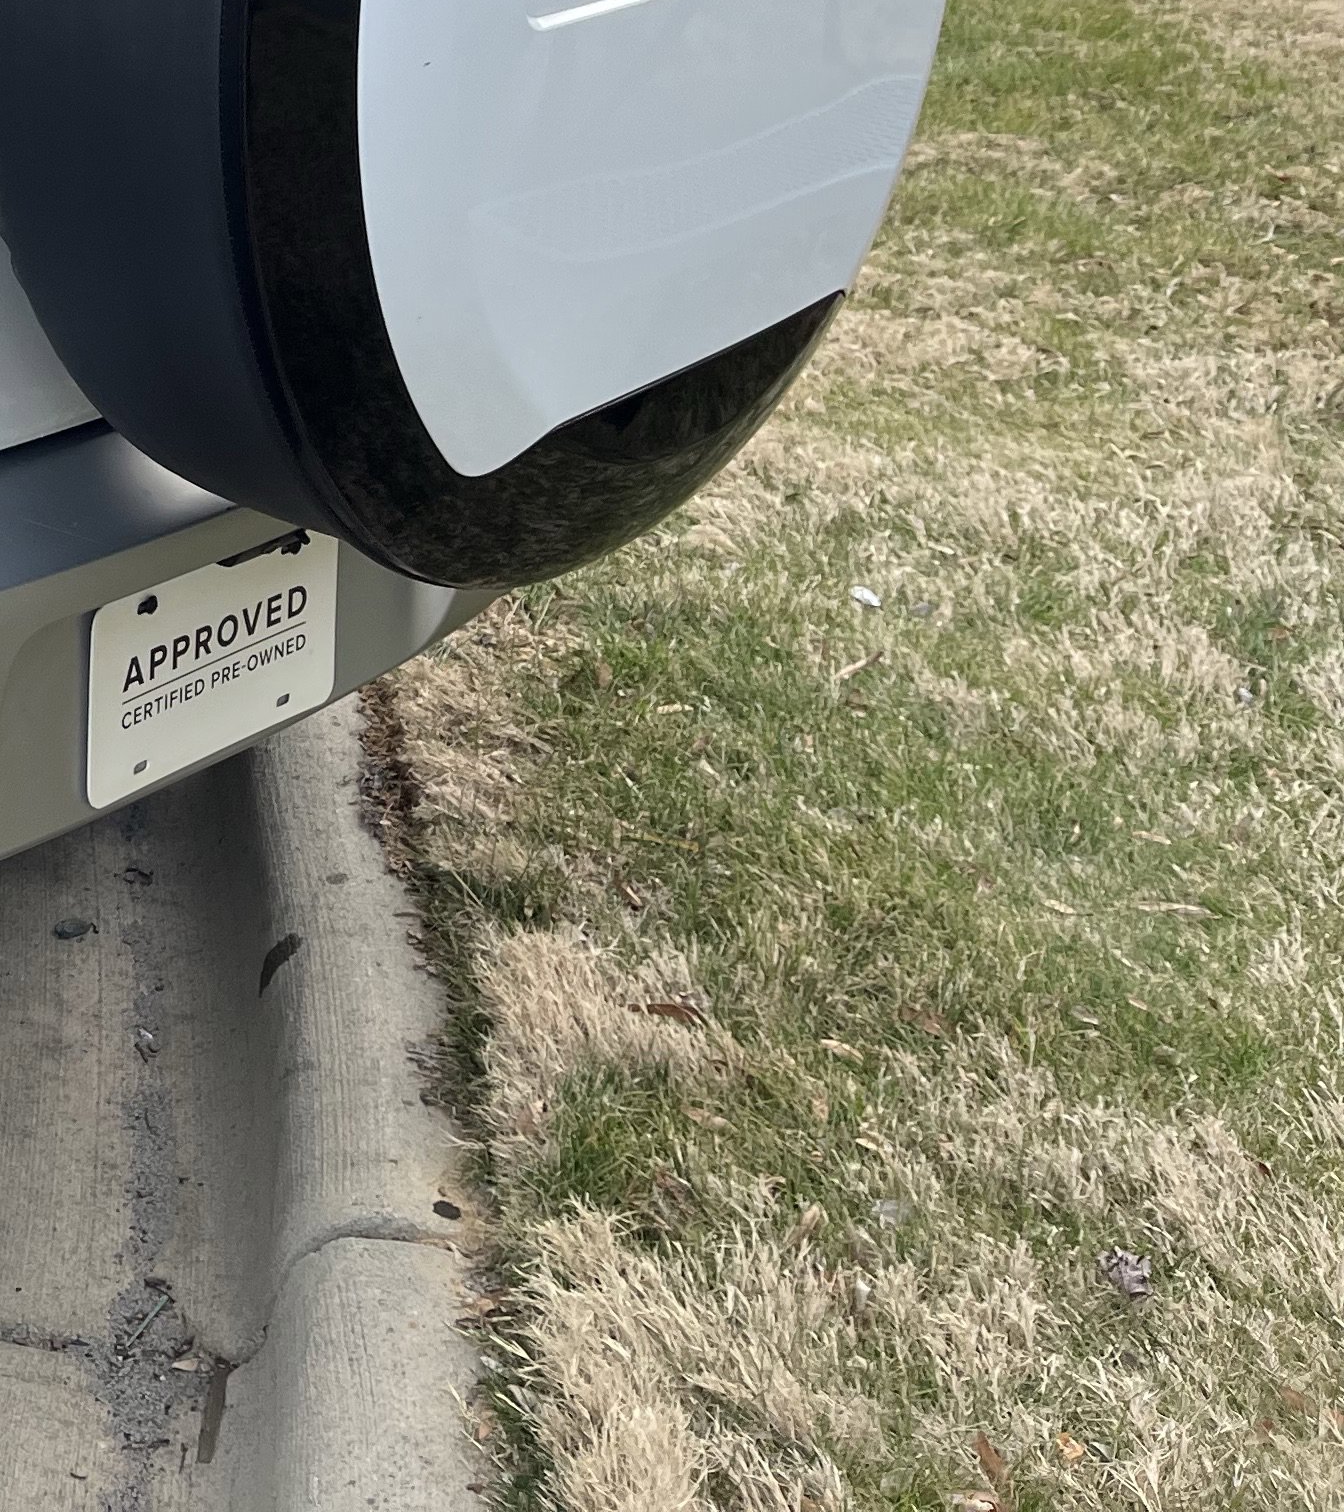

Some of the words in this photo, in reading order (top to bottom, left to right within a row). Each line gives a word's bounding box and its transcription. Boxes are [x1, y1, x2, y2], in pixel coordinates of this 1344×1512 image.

[121, 678, 205, 730] CERTIFIED
[211, 633, 306, 689] PRE-OWNED
[122, 585, 308, 693] APPROVED
